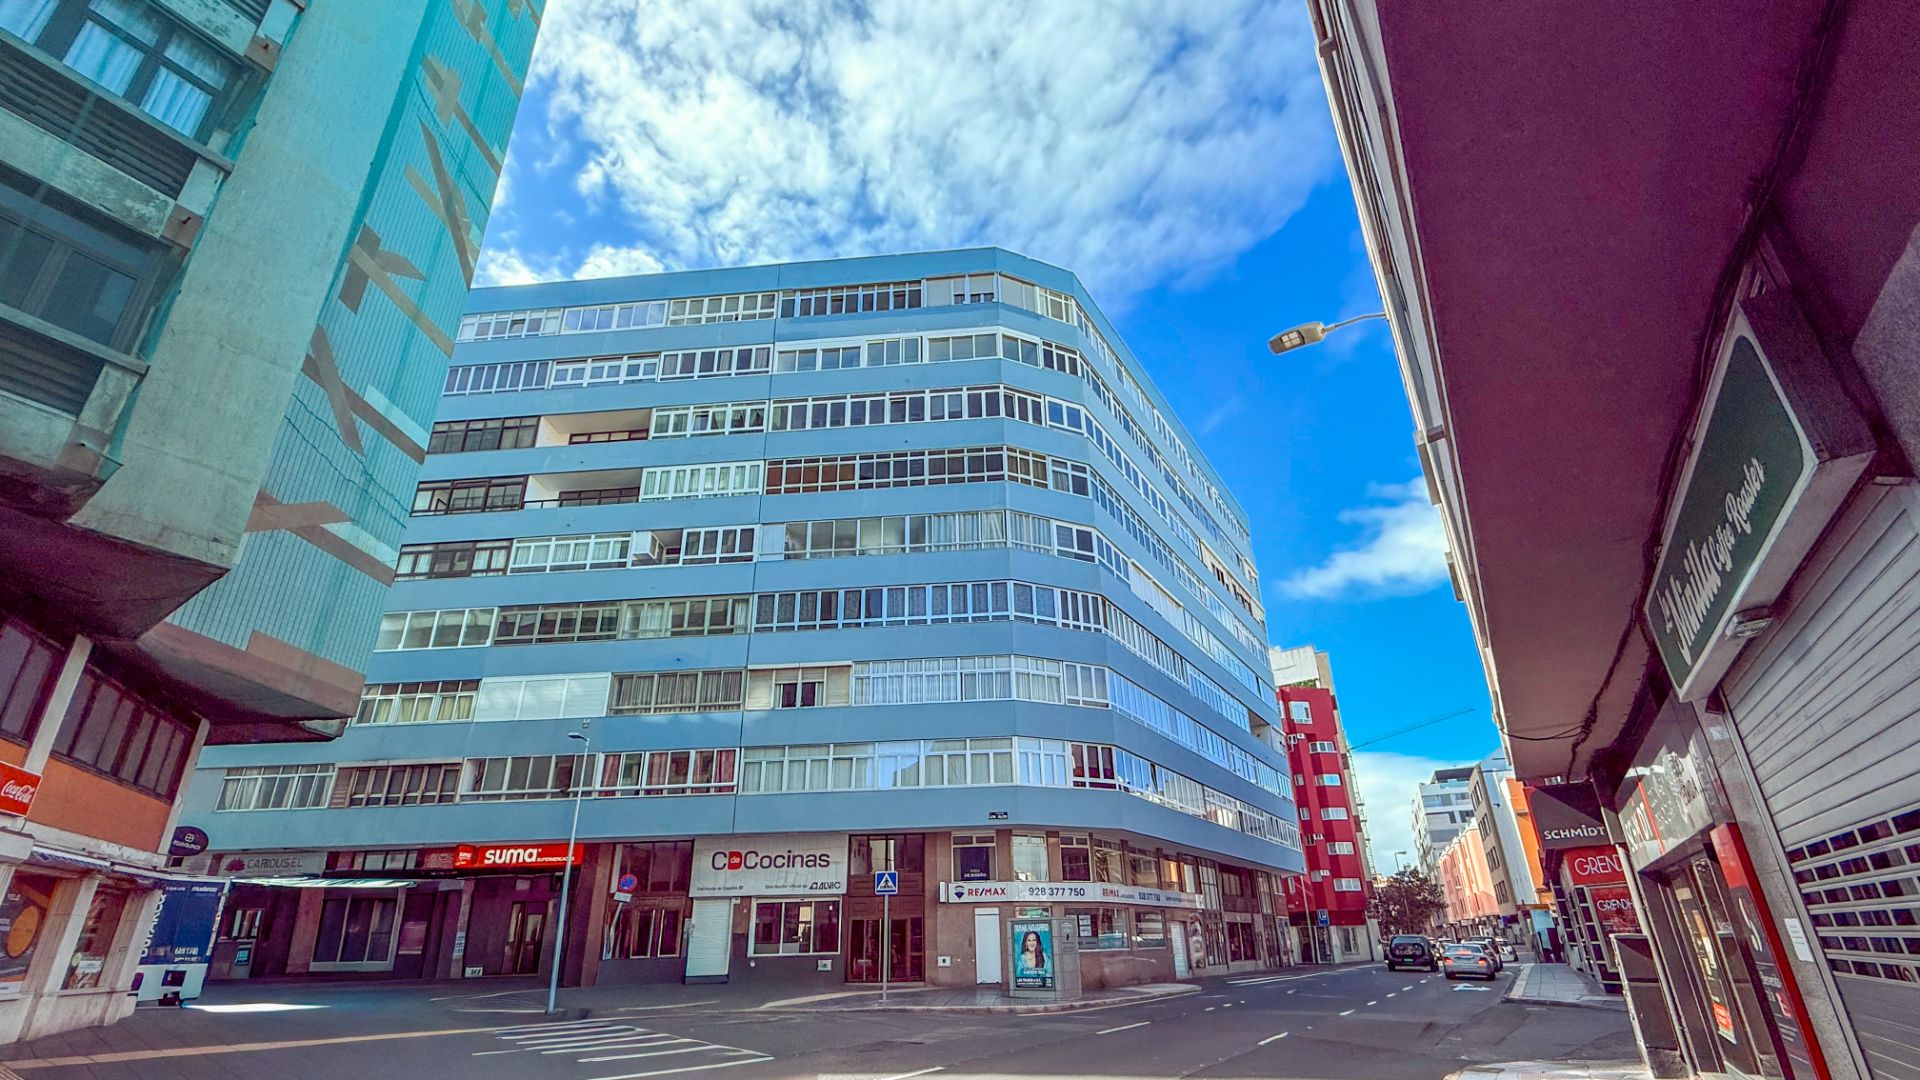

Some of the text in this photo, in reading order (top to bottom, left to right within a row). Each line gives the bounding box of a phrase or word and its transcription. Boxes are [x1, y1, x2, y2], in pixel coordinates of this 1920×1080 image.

[1708, 524, 1736, 573] Coffee
[1725, 457, 1765, 535] Roaster
[484, 848, 537, 865] suma
[967, 888, 1006, 897] RE/MAX
[1028, 887, 1085, 897] 928 377 750
